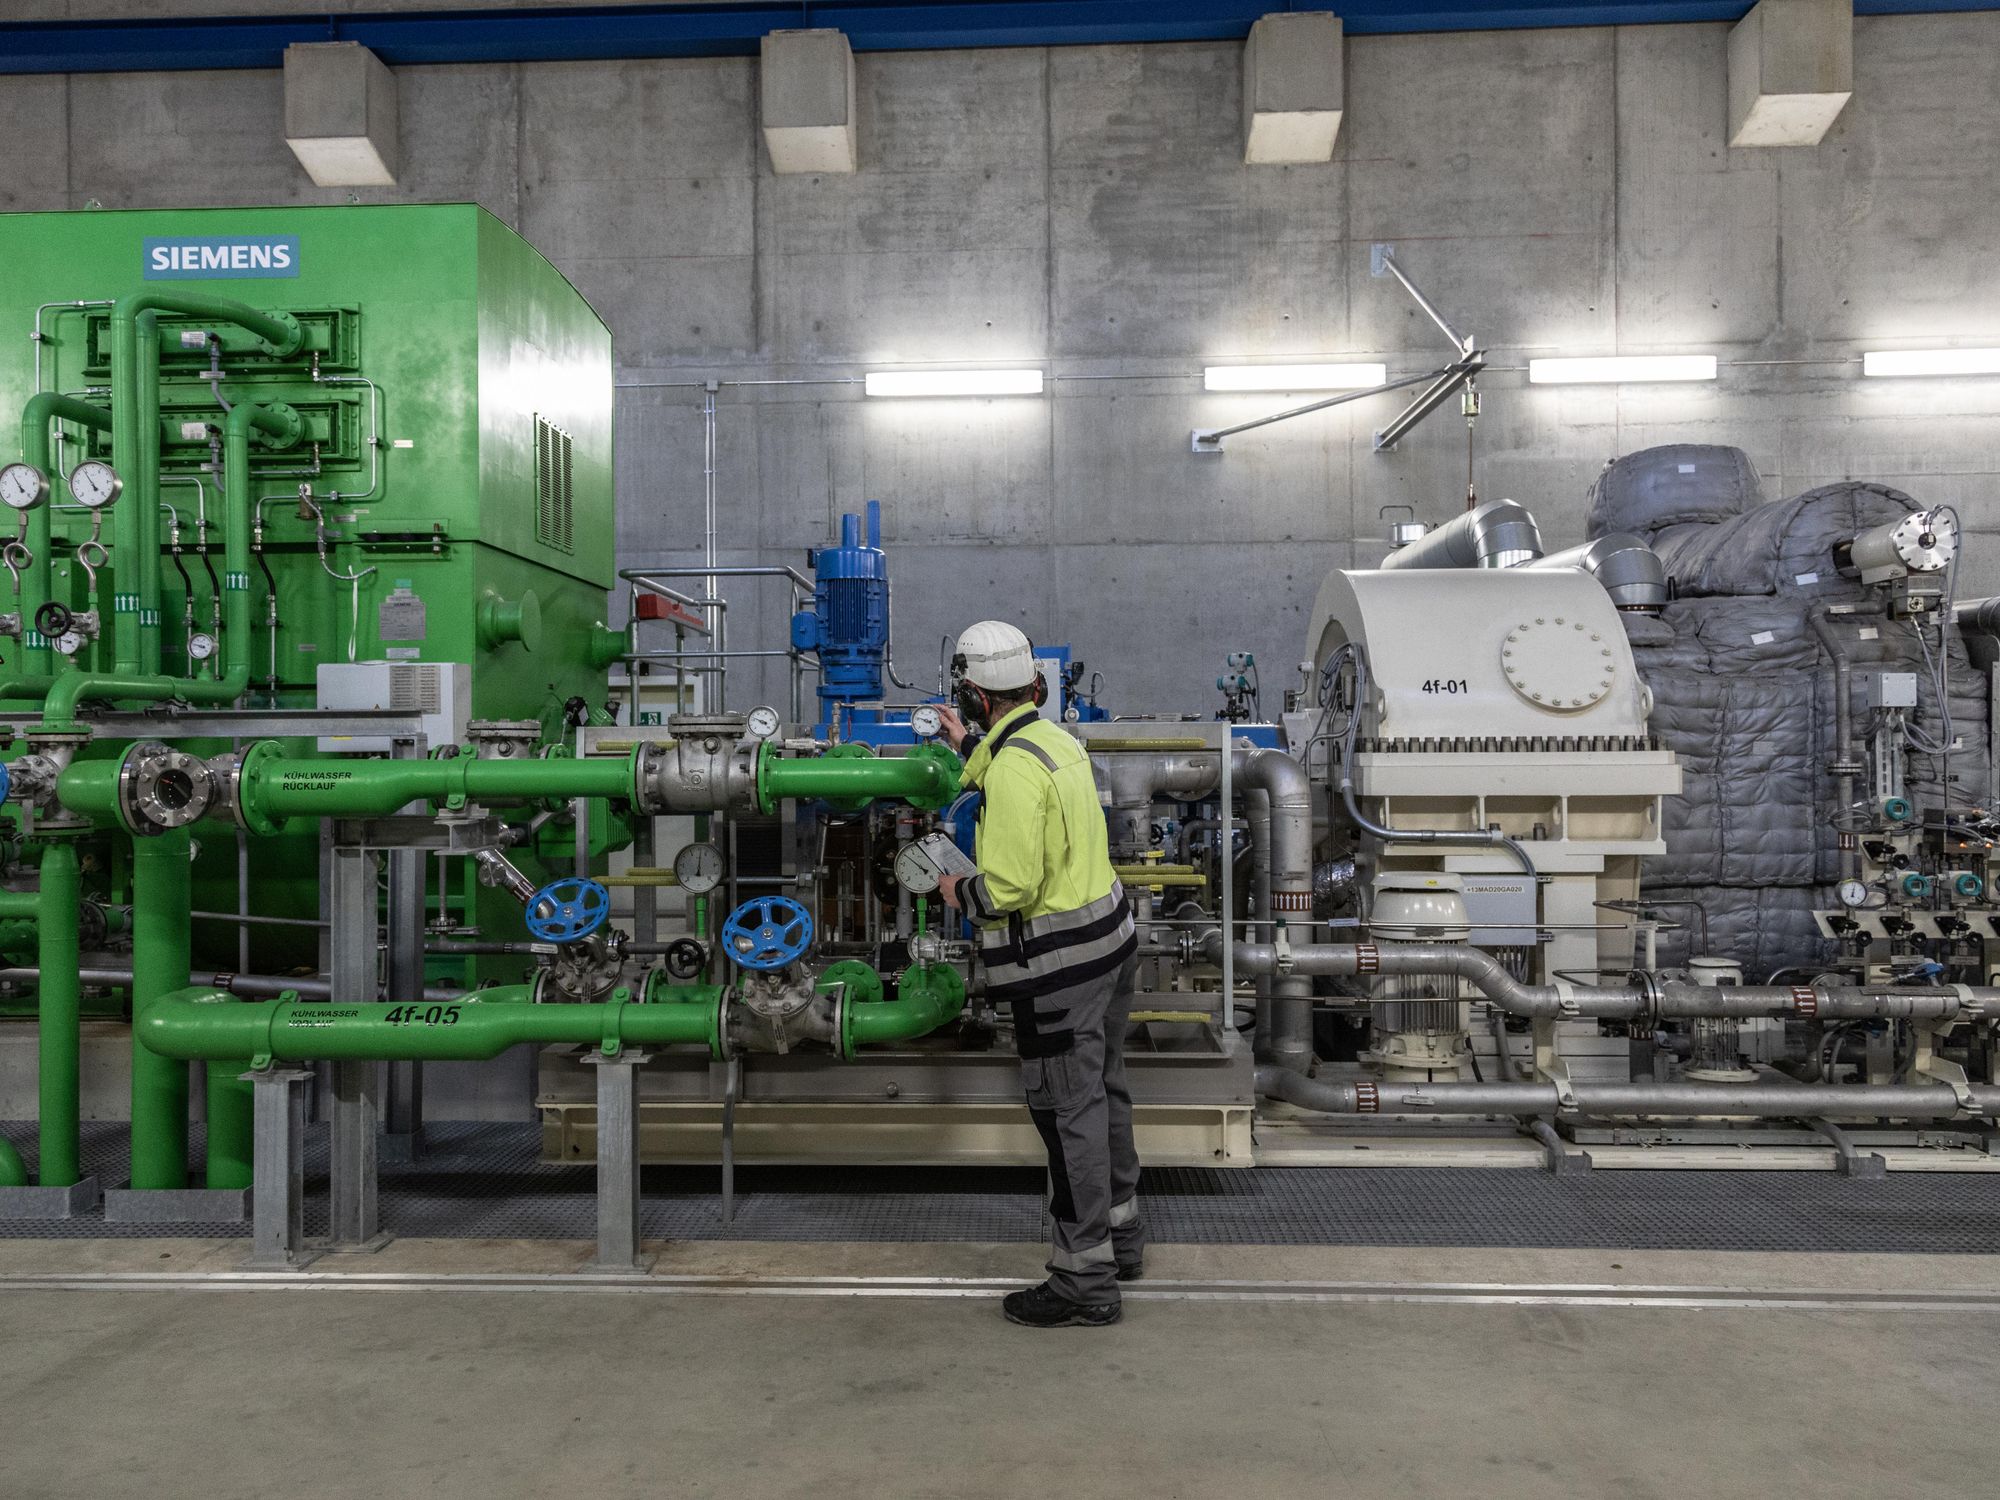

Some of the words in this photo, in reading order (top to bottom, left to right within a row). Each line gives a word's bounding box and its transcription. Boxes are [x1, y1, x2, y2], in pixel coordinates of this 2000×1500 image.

[152, 244, 291, 271] SIEMENS
[1421, 679, 1468, 694] 4f-01
[283, 770, 352, 780] KÜHLWASSER
[282, 781, 337, 791] RÜCKLAUF
[385, 1005, 462, 1027] 4f-05
